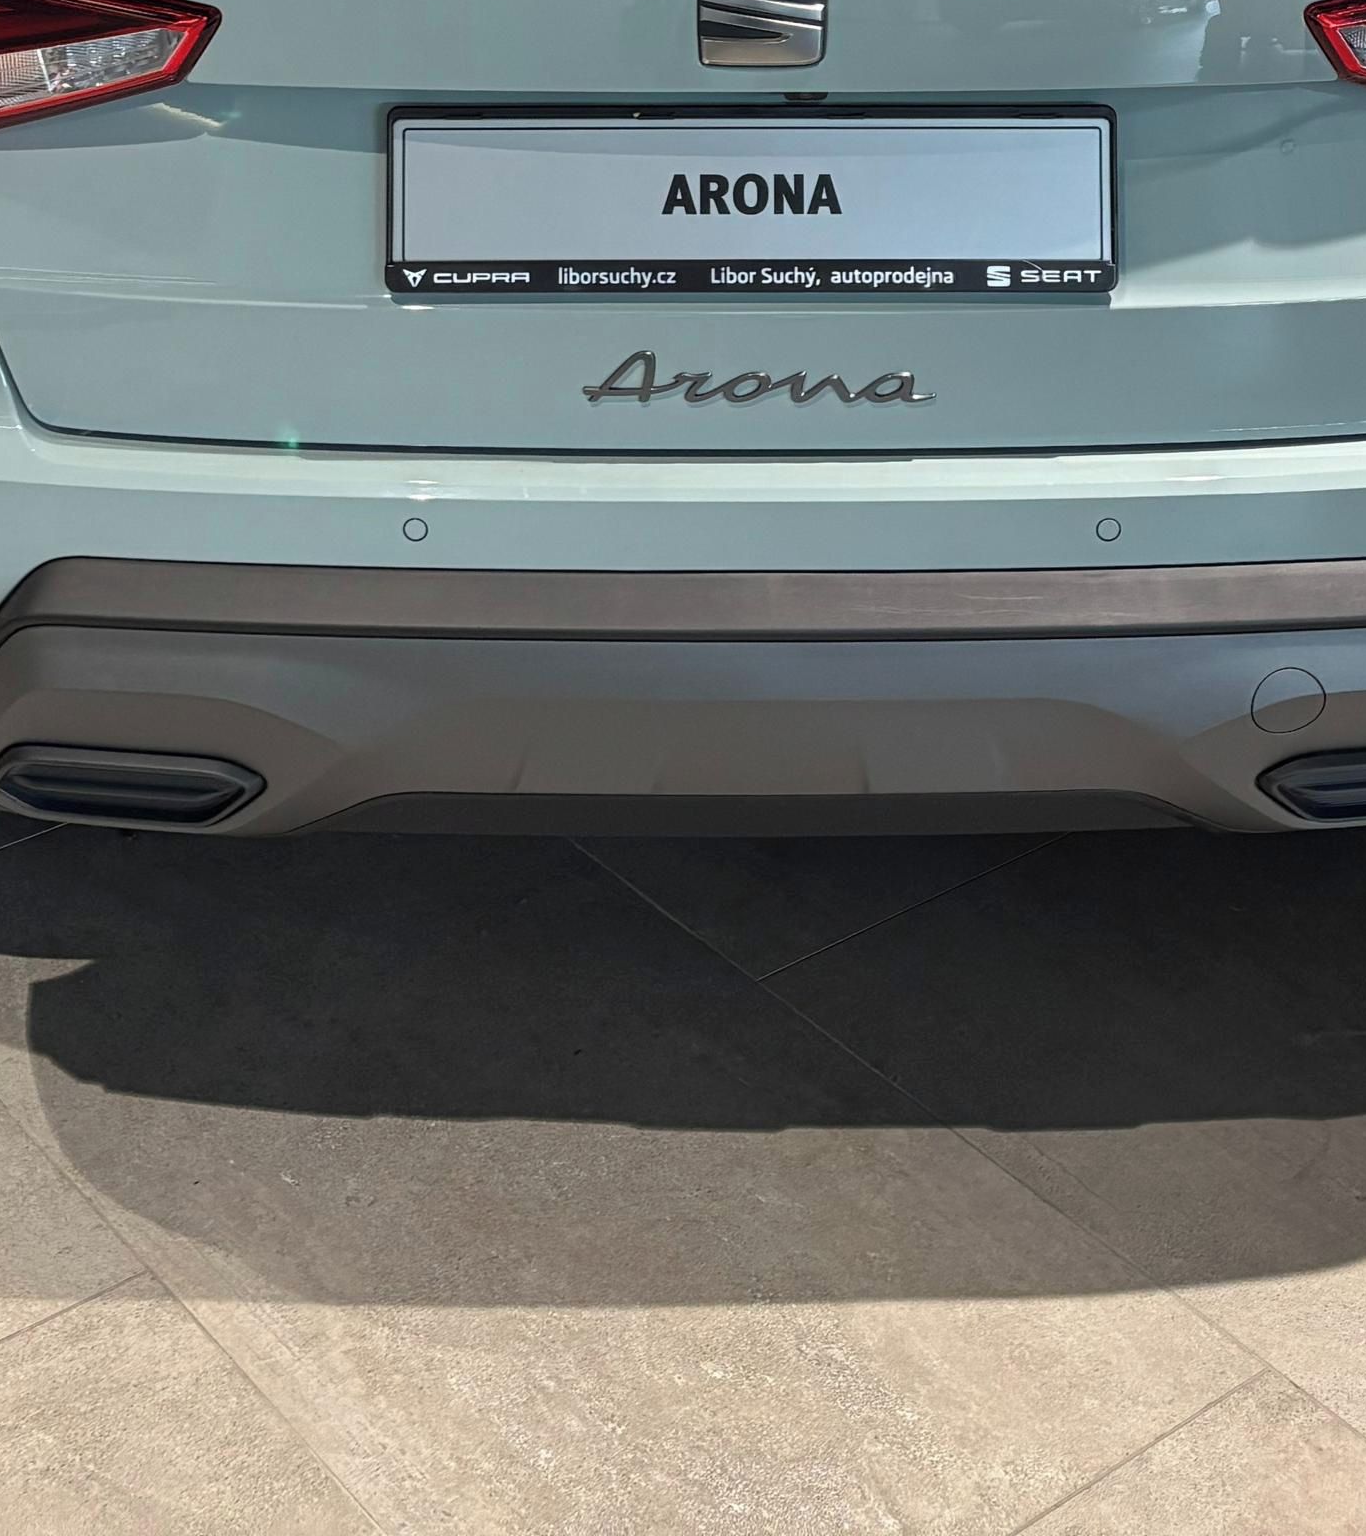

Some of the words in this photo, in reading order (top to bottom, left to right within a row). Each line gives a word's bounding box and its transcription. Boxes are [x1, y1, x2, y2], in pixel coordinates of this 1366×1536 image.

[661, 173, 843, 216] ARONA
[433, 271, 531, 284] CUPRA
[558, 266, 677, 289] liborsuchy.cz
[710, 266, 757, 285] Libor
[760, 266, 821, 288] Suchý,
[830, 267, 954, 289] autoprodejna
[1020, 269, 1102, 283] SEAT
[582, 350, 936, 403] Arona
